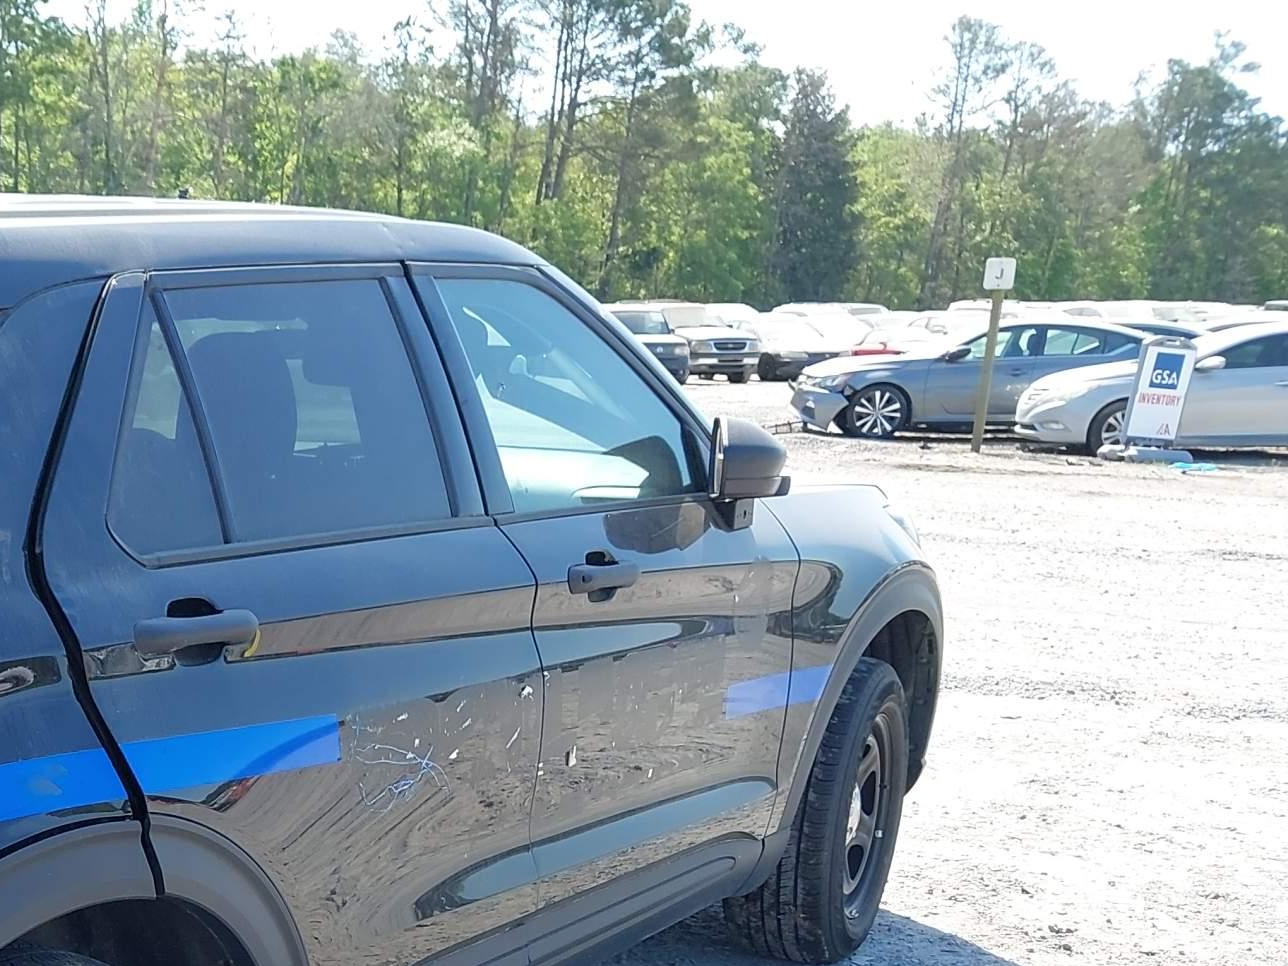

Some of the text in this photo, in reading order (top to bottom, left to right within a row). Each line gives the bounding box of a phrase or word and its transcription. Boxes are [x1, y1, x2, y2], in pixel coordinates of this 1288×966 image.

[994, 267, 1004, 280] J
[1151, 368, 1178, 386] GSA
[1137, 392, 1183, 408] INVENTORY
